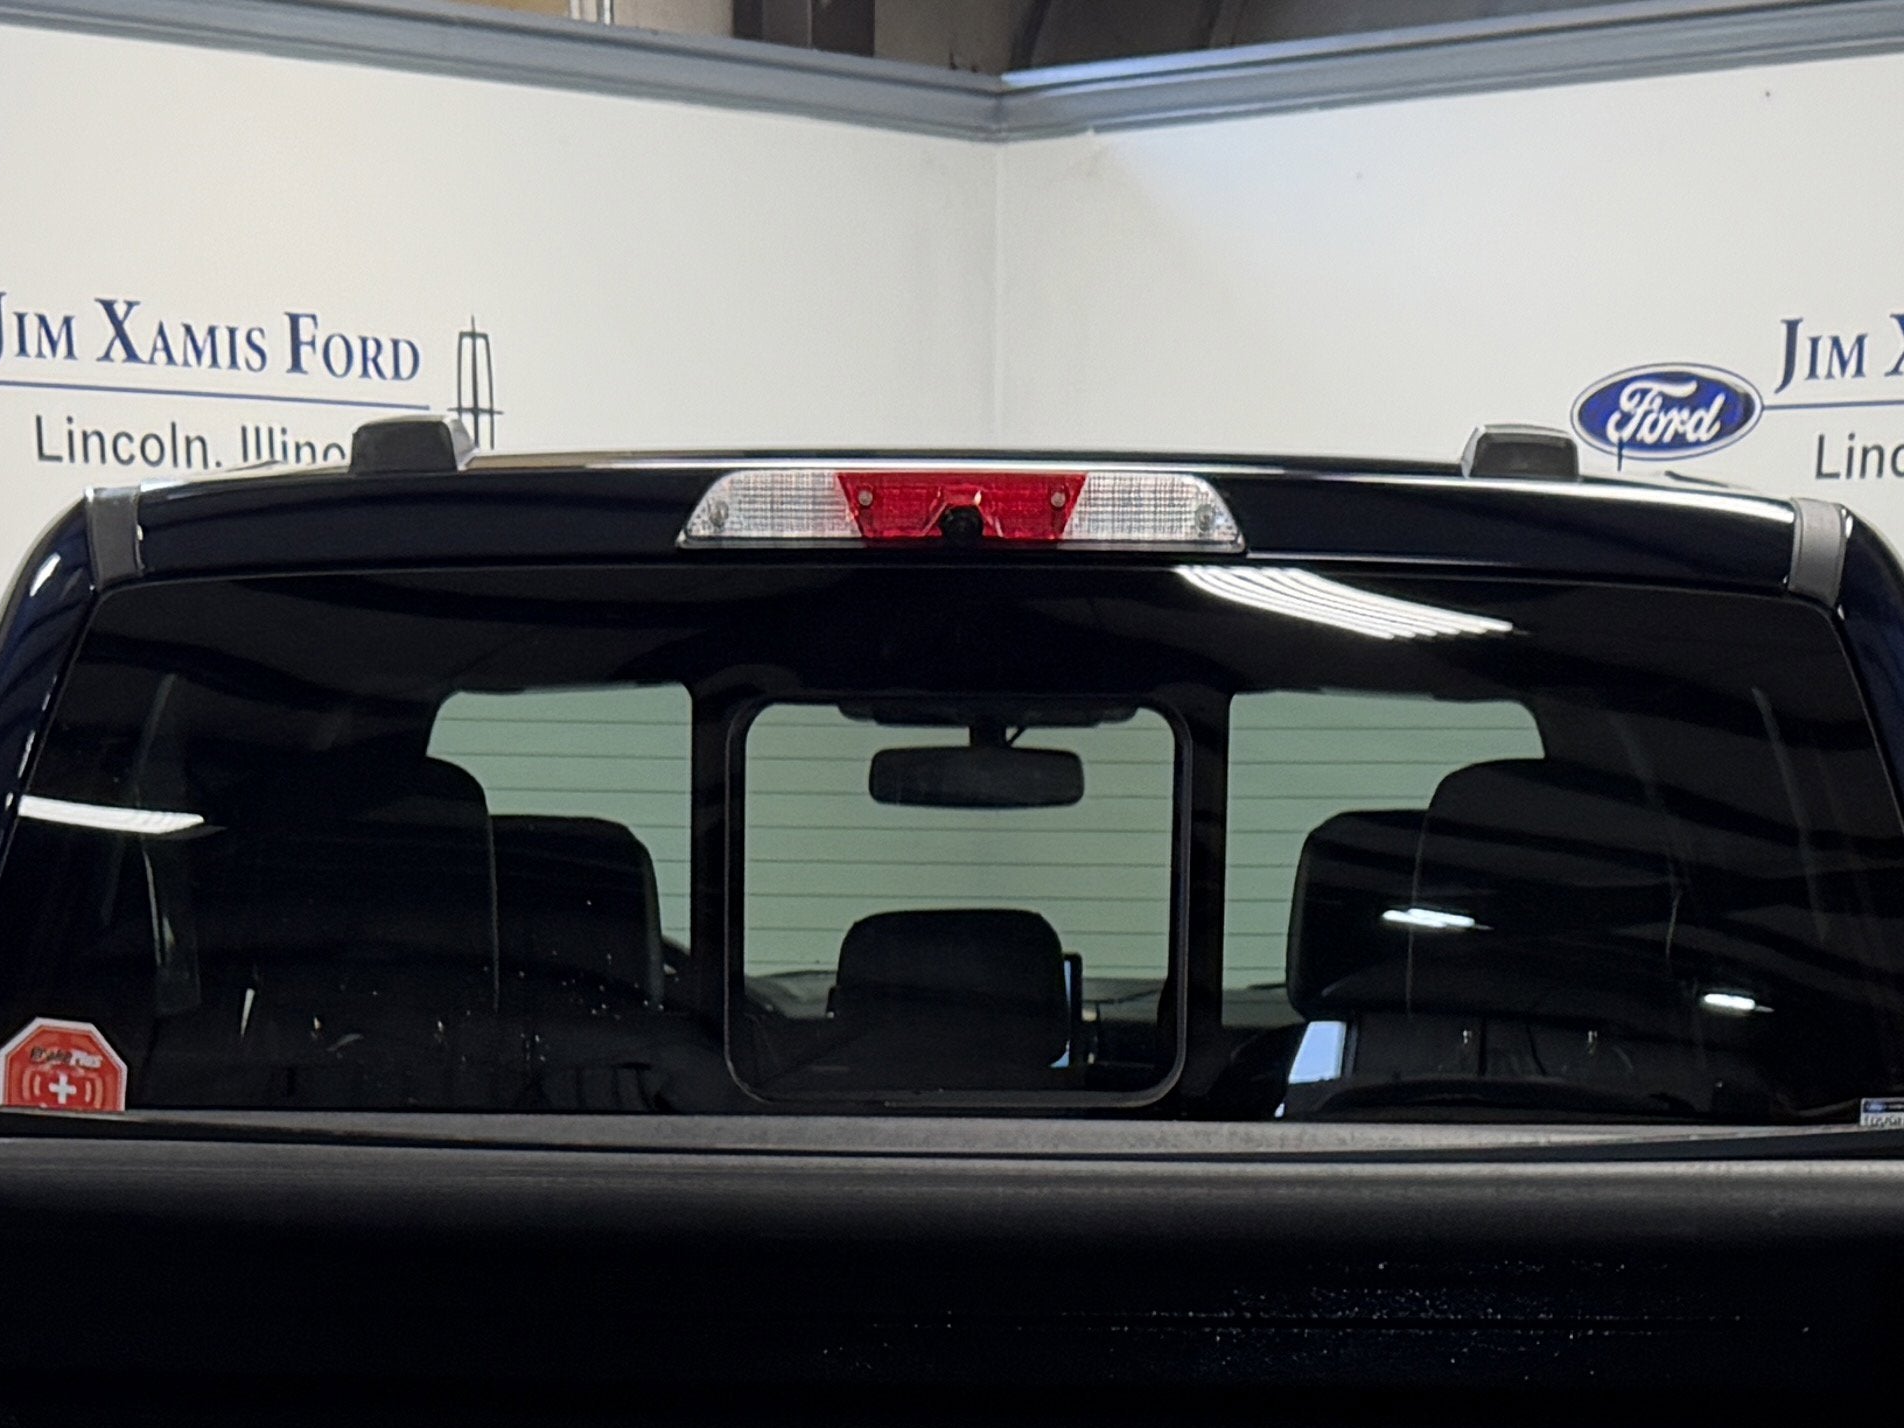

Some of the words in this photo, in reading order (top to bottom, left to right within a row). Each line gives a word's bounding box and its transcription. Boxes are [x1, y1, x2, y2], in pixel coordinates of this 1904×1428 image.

[95, 297, 269, 374] XAMIS
[284, 311, 421, 381] FORD
[1774, 317, 1868, 395] JIM
[240, 424, 347, 465] Illino
[1606, 379, 1727, 444] Ford
